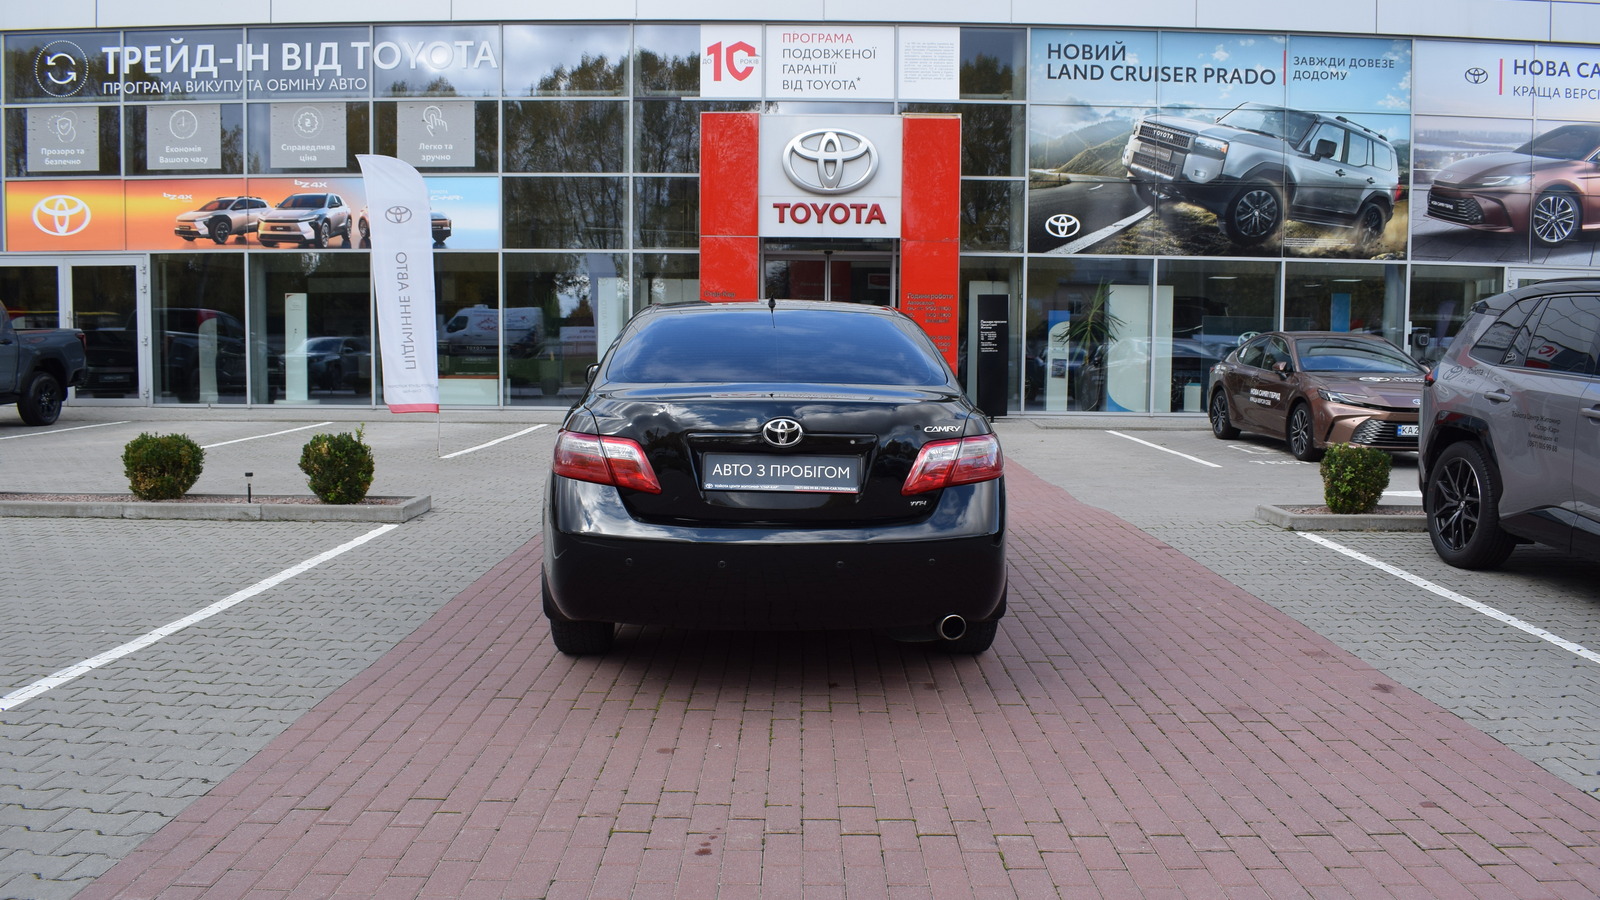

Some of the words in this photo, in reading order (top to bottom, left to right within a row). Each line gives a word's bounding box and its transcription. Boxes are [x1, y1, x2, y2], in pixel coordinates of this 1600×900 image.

[782, 32, 854, 44] ПРОГРАМА
[782, 47, 877, 60] ПОДОВЖЕНОЇ
[1047, 40, 1126, 62] НОВИЙ
[101, 38, 269, 79] ТРЕЙД-ІН
[282, 42, 342, 77] ВІД
[351, 40, 498, 70] TOYOTA
[1293, 55, 1346, 68] ЗАВЖДИ
[1349, 57, 1395, 69] ДОВЕЗЕ
[782, 62, 836, 75] ГАРАНТІЇ
[1514, 59, 1570, 77] НОВА
[1047, 63, 1104, 80] LAND
[1110, 65, 1198, 83] CRUISER
[1204, 68, 1276, 86] PRADO
[1292, 70, 1348, 82] ДОДОМУ
[104, 82, 181, 94] ПРОГРАМА
[186, 80, 242, 93] ВИКУПУ
[246, 79, 263, 92] ТА
[267, 78, 326, 92] ОБМІНУ
[329, 77, 367, 90] АВТО
[782, 80, 804, 92] ВІД
[1513, 86, 1560, 99] КРАЩА
[1153, 130, 1174, 140] TOYOTA
[41, 148, 76, 157] Прозоро
[165, 146, 202, 154] Економія
[281, 144, 336, 152] Справедлива
[418, 143, 442, 151] Легко
[44, 157, 82, 166] безпечно
[159, 156, 188, 164] Вашого
[190, 156, 208, 165] часу
[299, 153, 318, 162] ціна
[422, 154, 450, 162] зручно
[772, 202, 887, 224] TOYOTA
[712, 464, 753, 476] АВТО
[756, 464, 766, 476] З
[770, 465, 850, 479] ПРОБІГОМ
